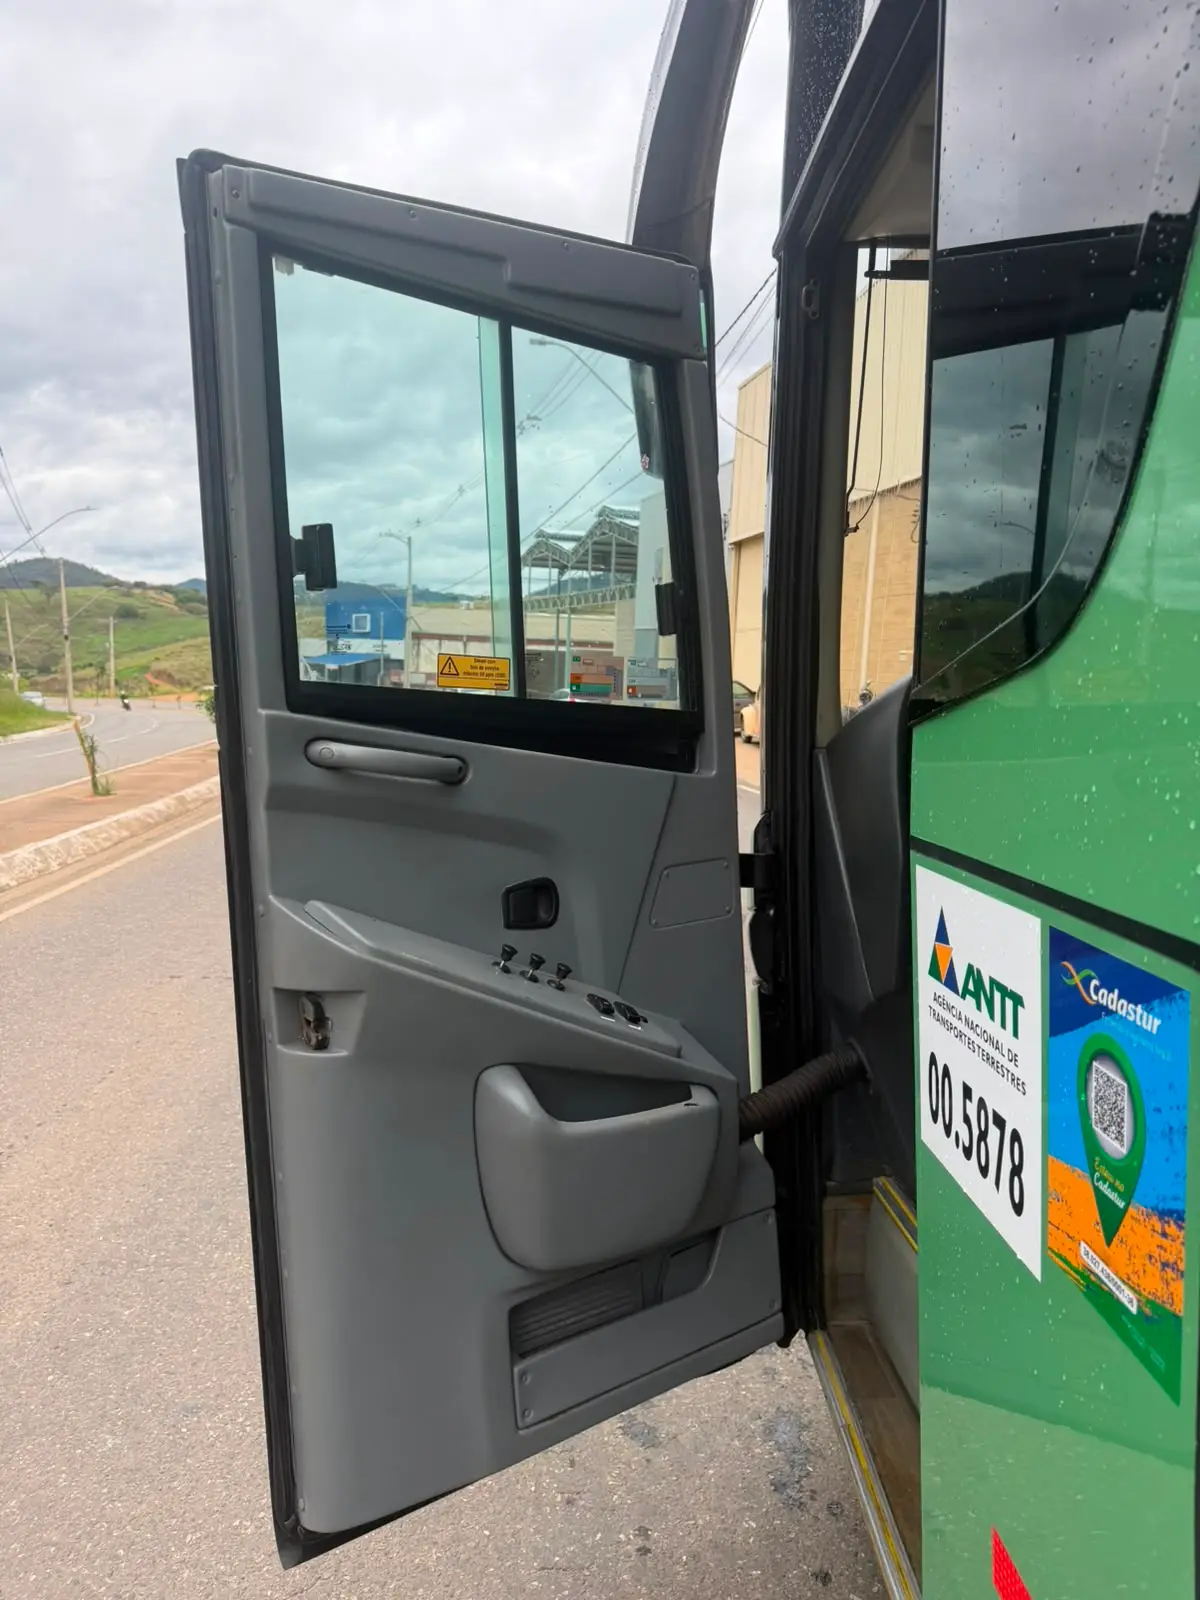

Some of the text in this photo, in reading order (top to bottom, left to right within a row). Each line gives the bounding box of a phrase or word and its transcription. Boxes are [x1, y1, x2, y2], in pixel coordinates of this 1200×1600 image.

[932, 991, 1020, 1068] AGÊNCIA NACIONAL DE
[960, 962, 1026, 1041] ANTT
[1089, 978, 1163, 1035] Cadastur
[928, 1004, 1028, 1096] TRANSPORTES TERRESTRES
[928, 1051, 1025, 1218] 00.5878
[1093, 1171, 1126, 1209] Cadastur
